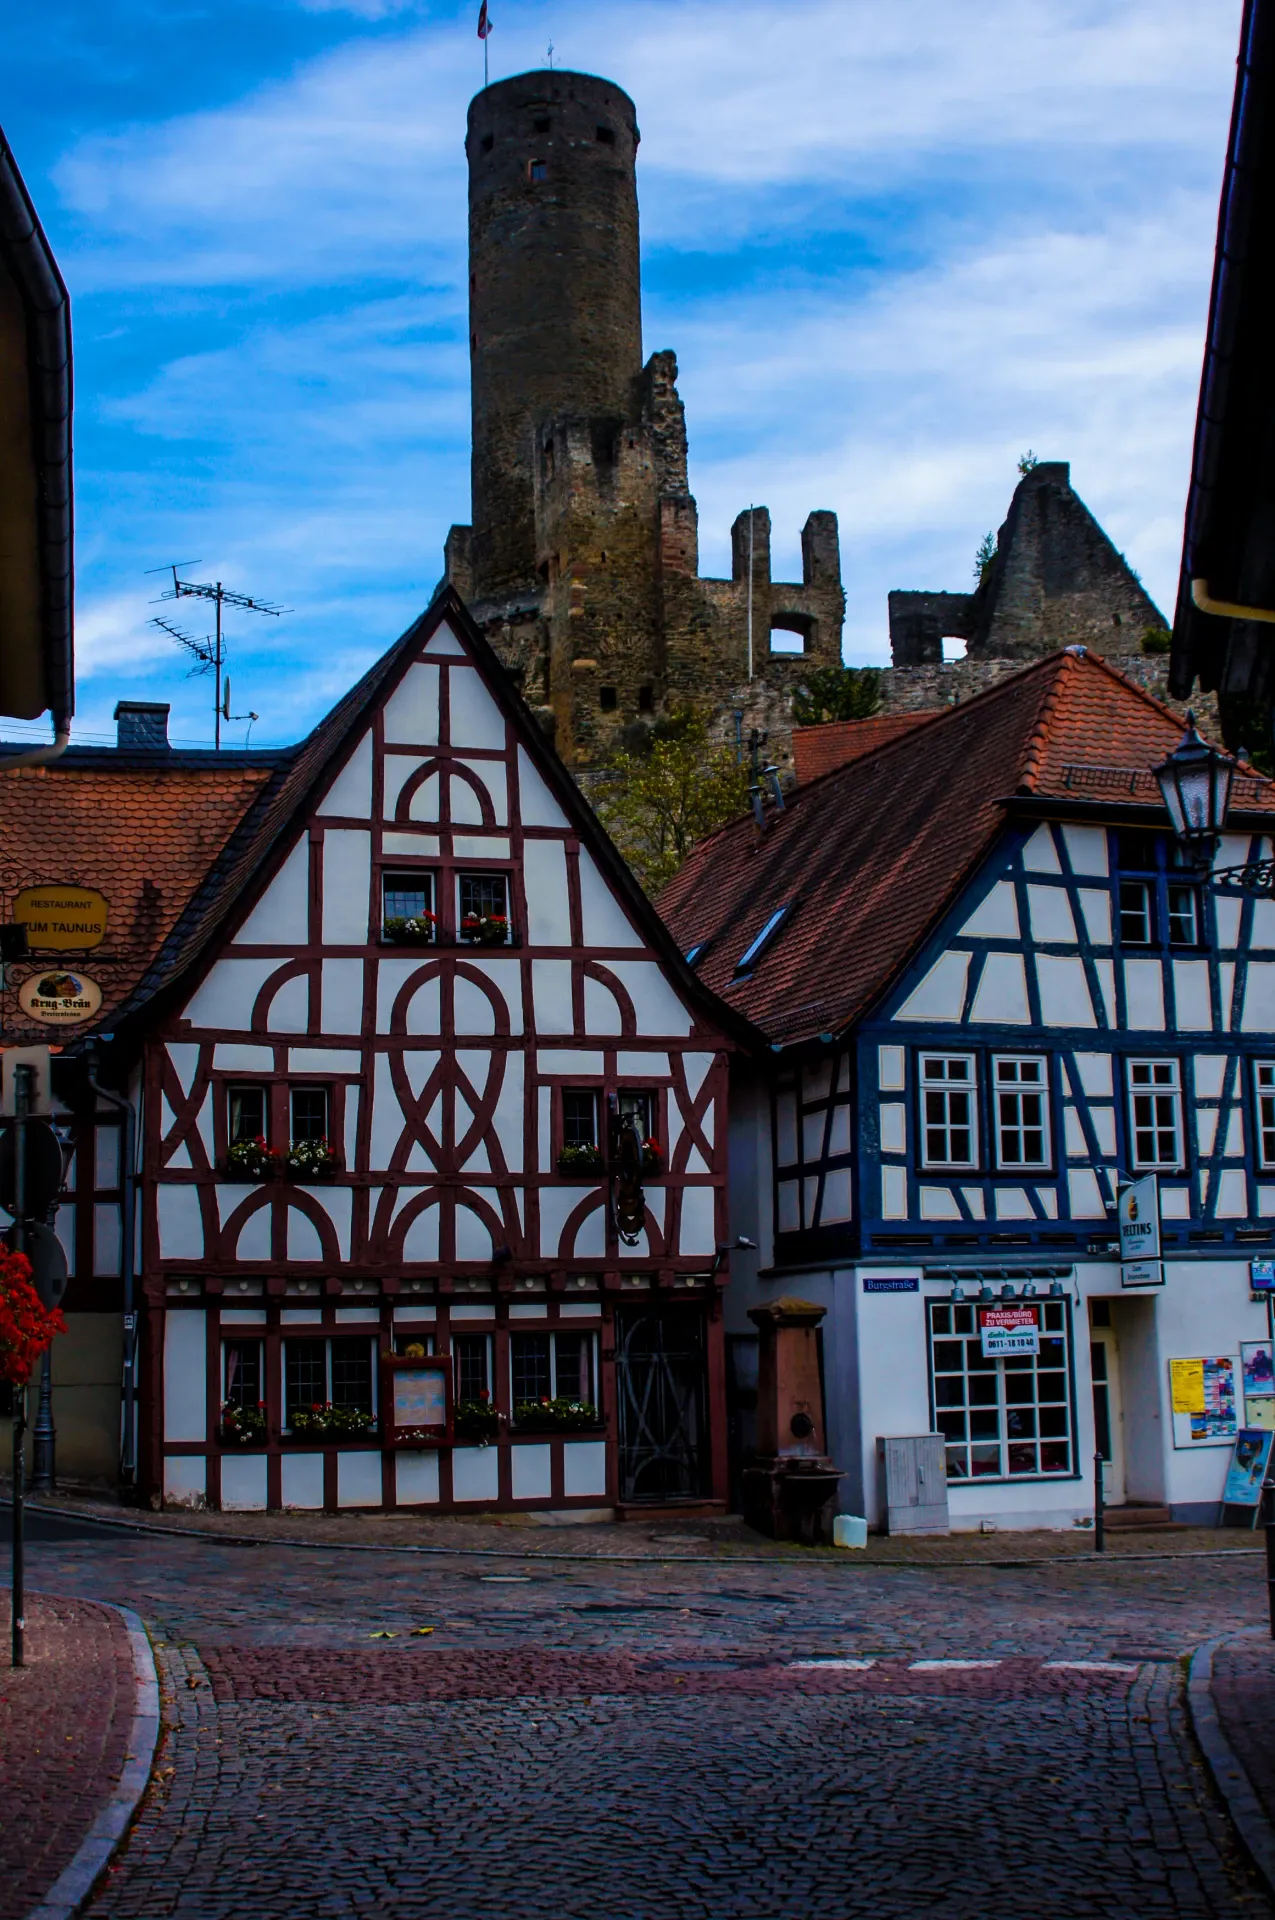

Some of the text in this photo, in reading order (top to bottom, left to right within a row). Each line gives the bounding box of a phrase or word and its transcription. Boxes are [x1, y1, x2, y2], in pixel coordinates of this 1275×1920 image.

[31, 900, 92, 909] RESTAURANT
[23, 922, 102, 933] ZUM TAUNUS
[30, 998, 91, 1010] Krug-Bräu
[1123, 1222, 1152, 1237] VELTINS
[867, 1279, 914, 1290] Burgstraße
[986, 1310, 1032, 1319] PRAXIS/BÜRO
[996, 1318, 1034, 1326] VERMIETEN
[1017, 1339, 1025, 1347] 10
[1026, 1338, 1034, 1346] 40
